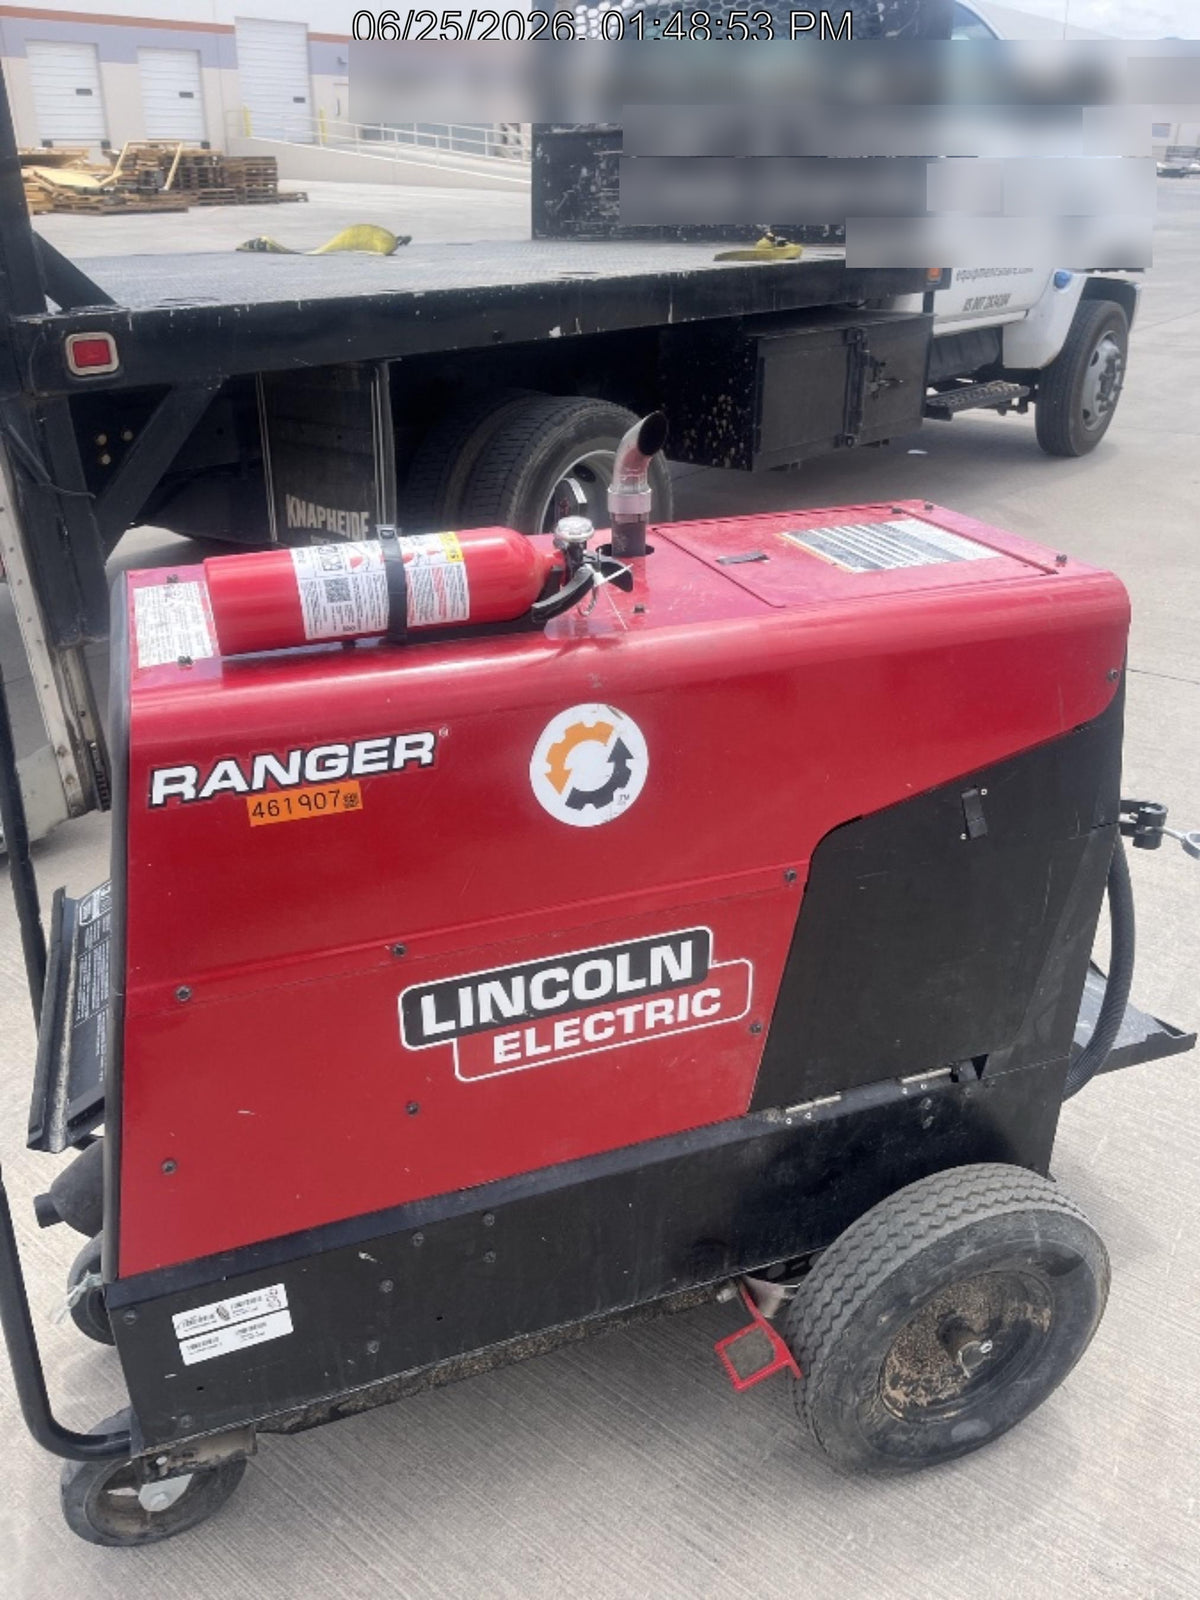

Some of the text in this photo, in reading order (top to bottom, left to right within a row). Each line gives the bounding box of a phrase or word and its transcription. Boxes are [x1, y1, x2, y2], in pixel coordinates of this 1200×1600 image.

[149, 731, 437, 807] RANGER
[252, 789, 340, 818] 461907
[420, 939, 693, 1036] LINCOLN
[493, 987, 721, 1064] ELECTRIC
